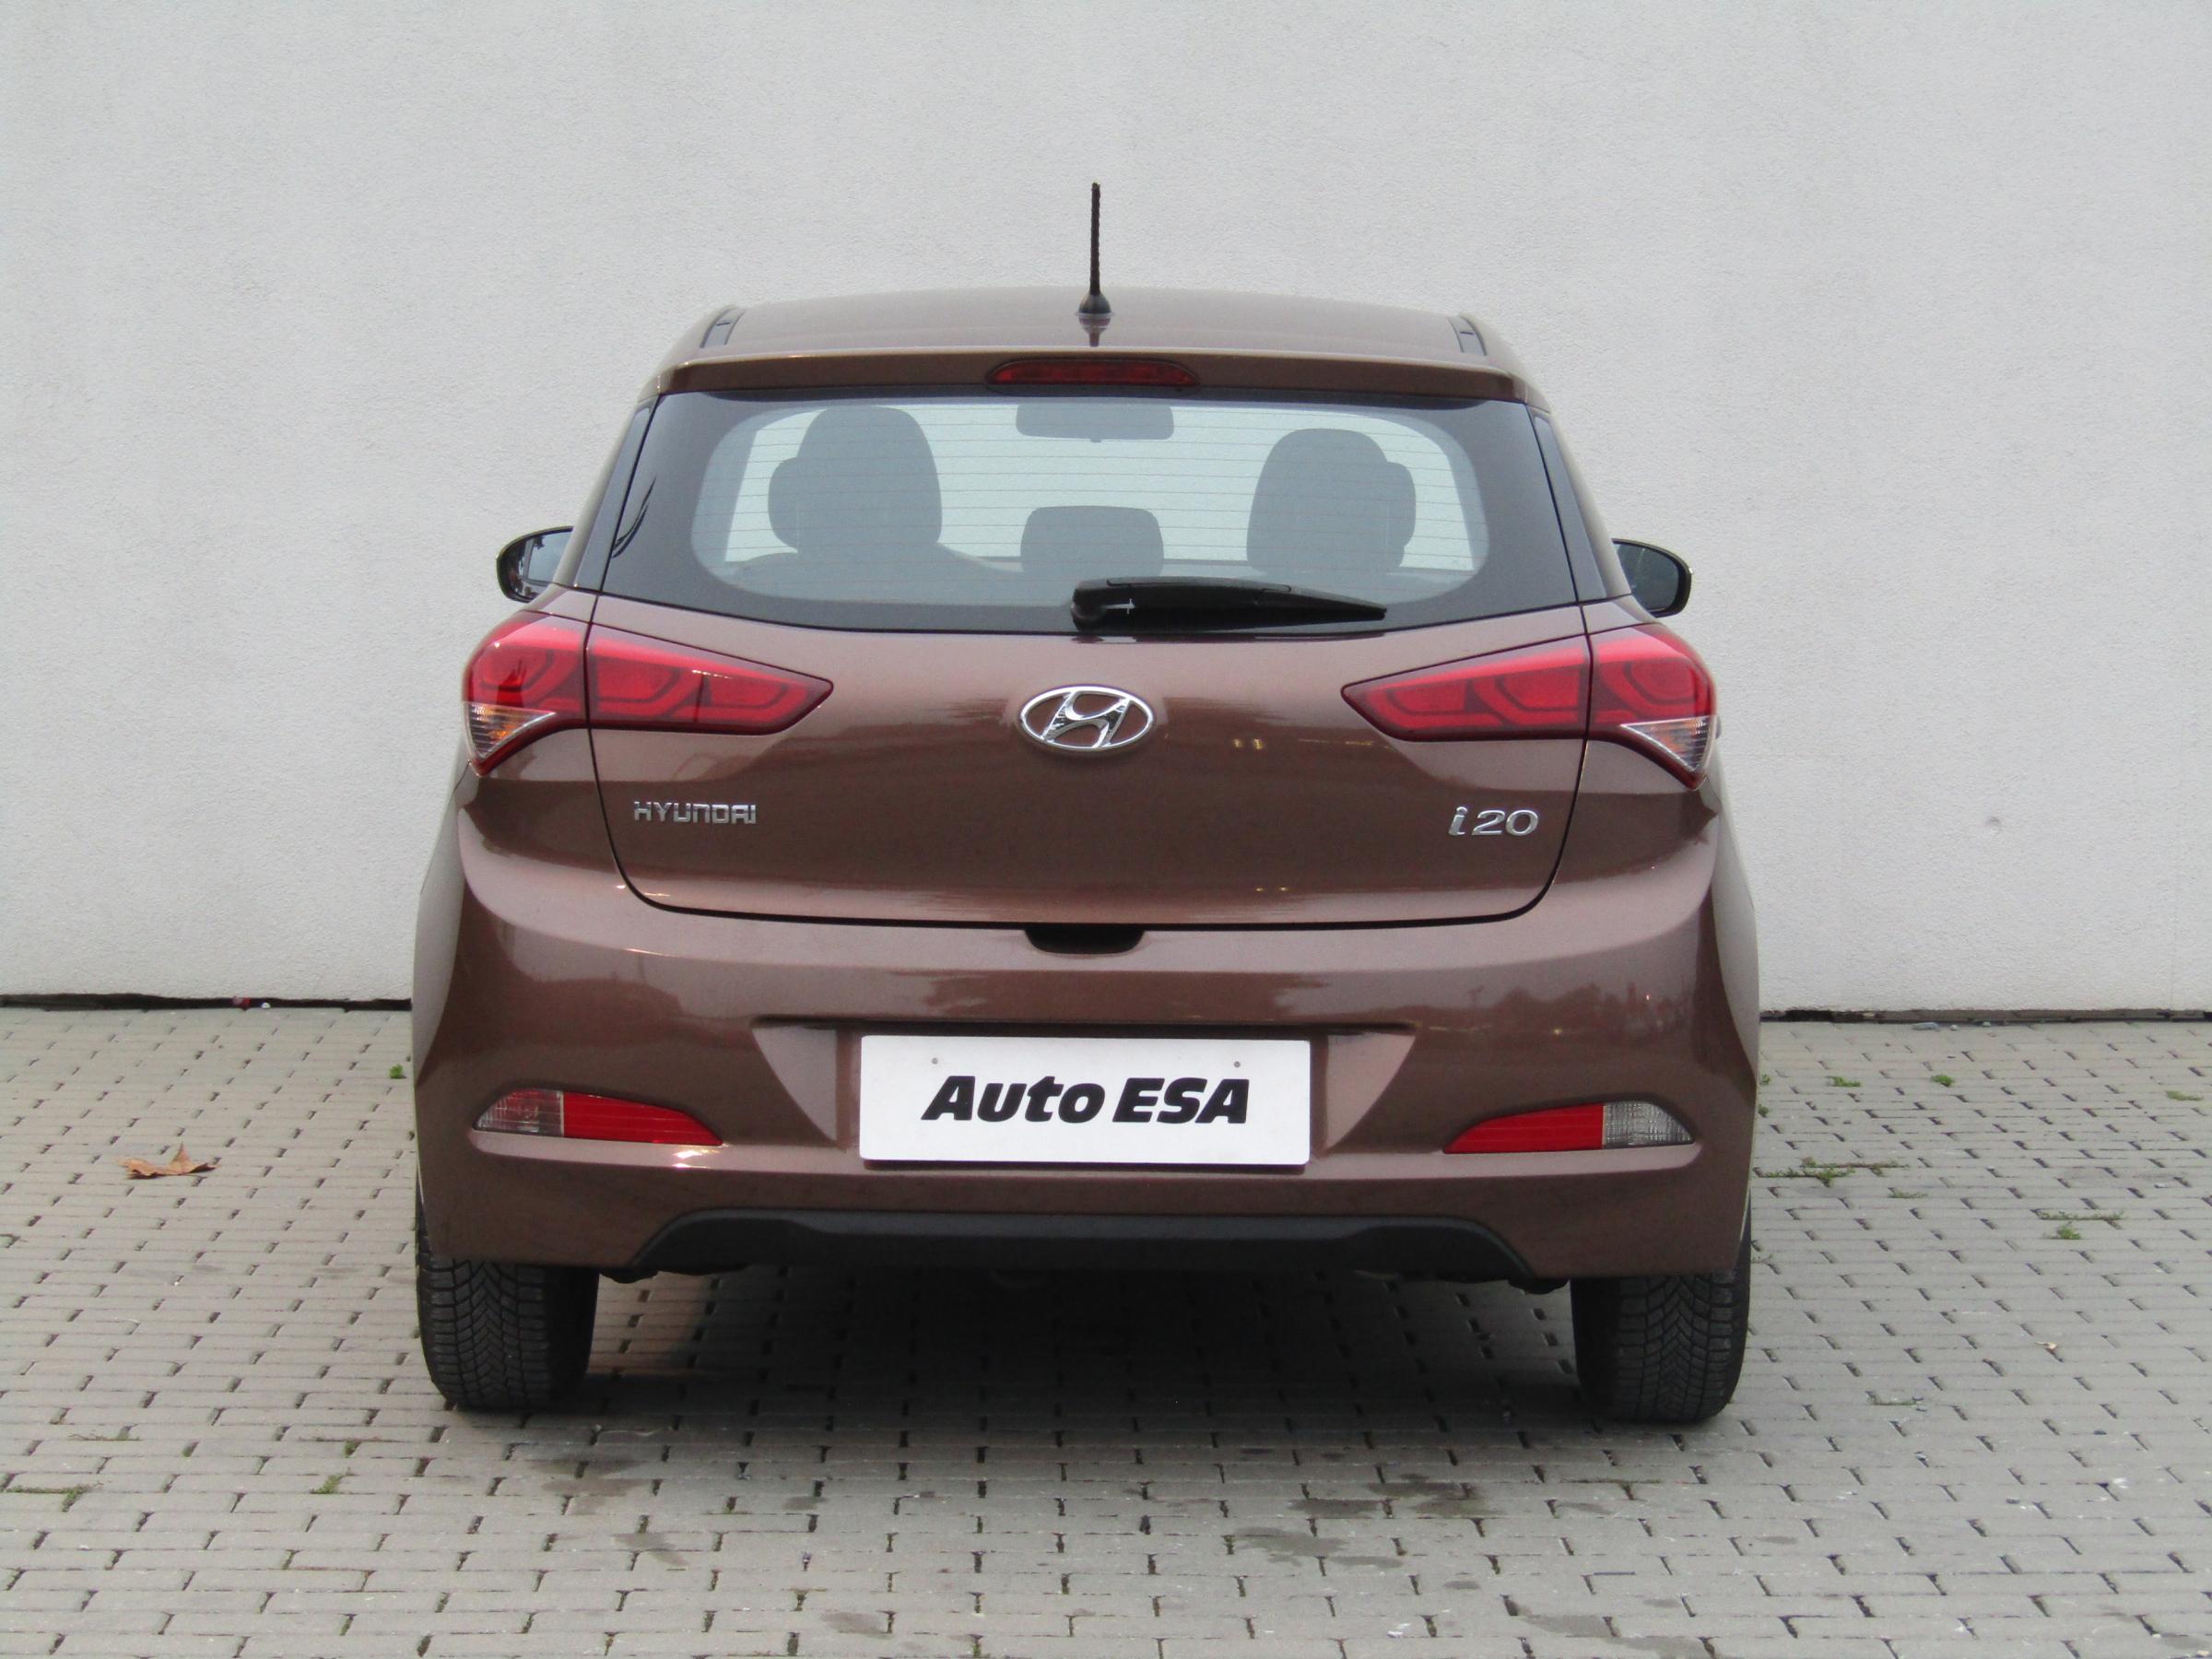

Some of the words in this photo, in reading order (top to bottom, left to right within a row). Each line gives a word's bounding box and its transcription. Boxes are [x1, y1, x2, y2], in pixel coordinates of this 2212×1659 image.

[633, 801, 757, 824] HYUNDAI
[1448, 806, 1539, 836] i20
[921, 1075, 1106, 1124] Auto
[1112, 1077, 1250, 1124] ESA
